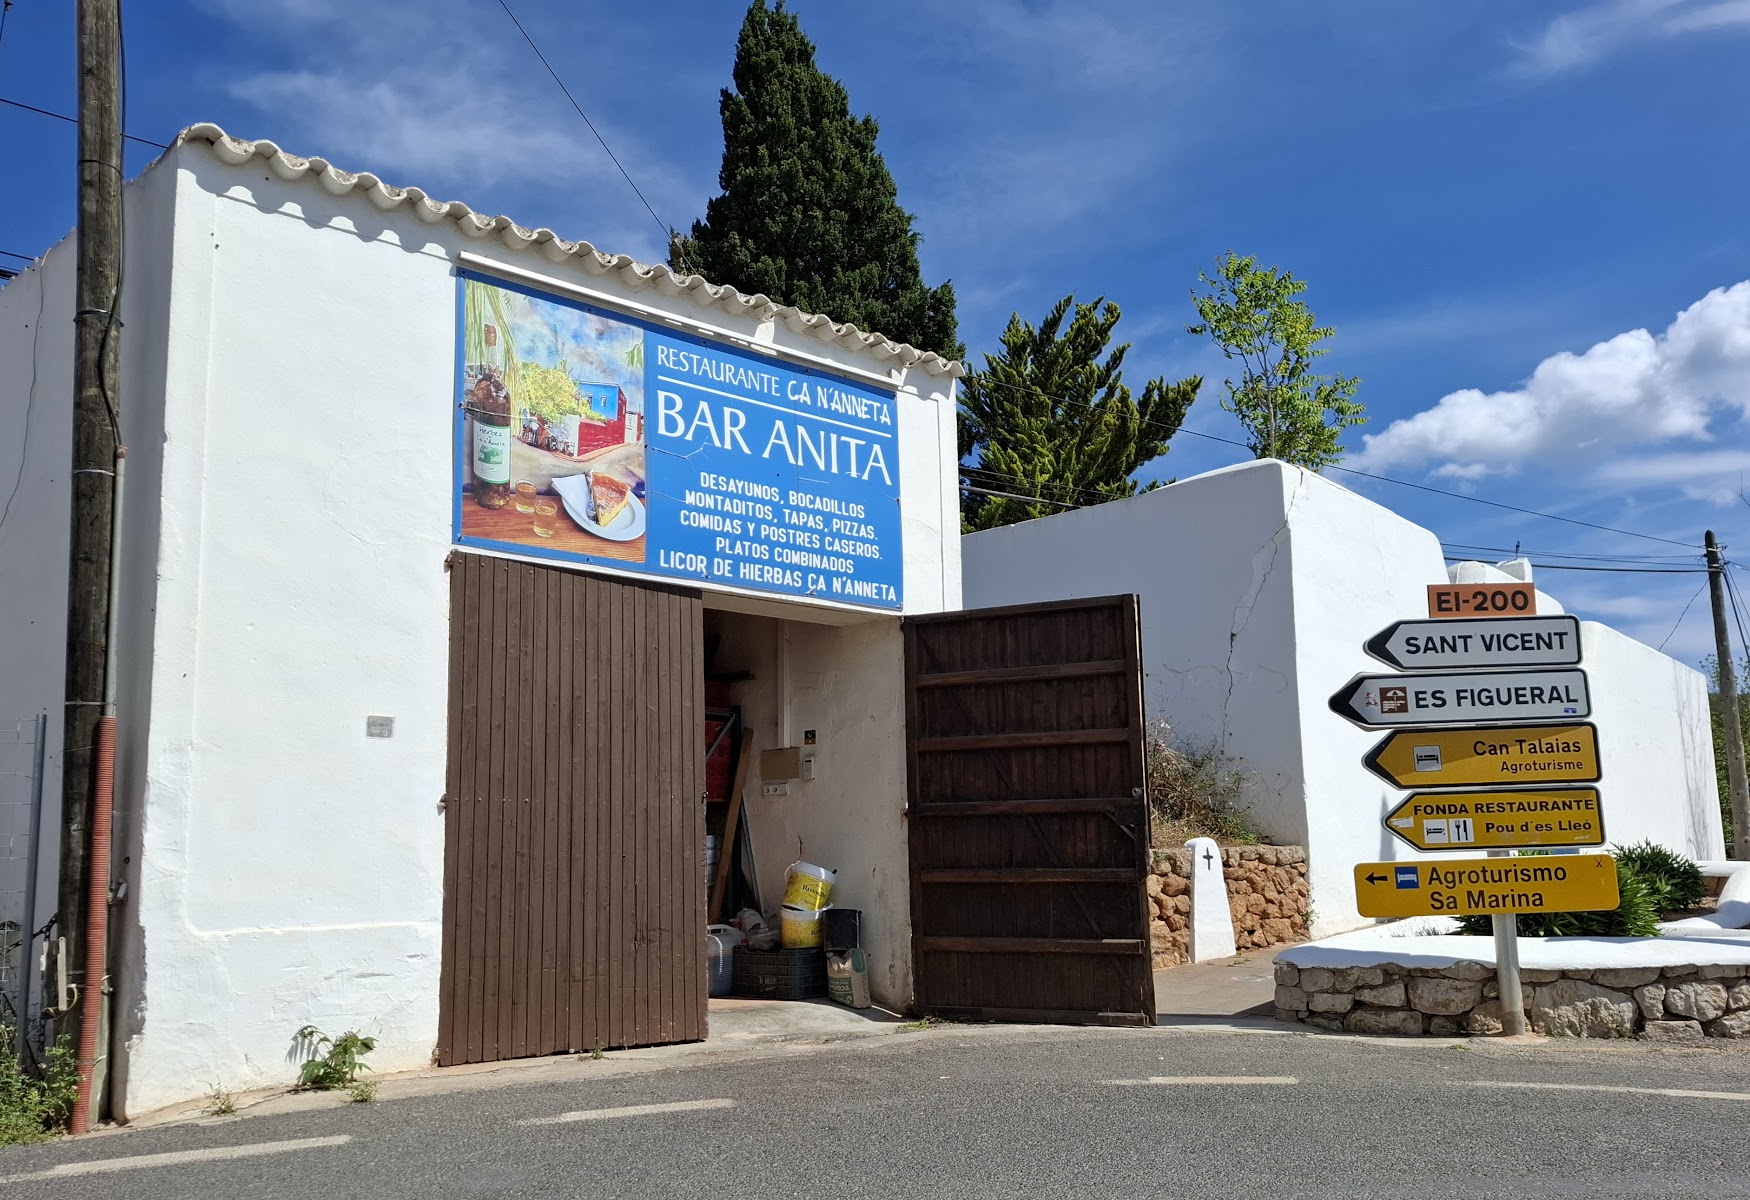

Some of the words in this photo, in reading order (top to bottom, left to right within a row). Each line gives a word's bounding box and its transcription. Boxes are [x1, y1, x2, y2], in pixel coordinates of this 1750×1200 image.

[657, 345, 780, 397] RESTAURANTE
[656, 389, 752, 455] BAR
[761, 419, 893, 486] ANITA
[700, 471, 785, 505] DESAYUNOS,
[788, 490, 865, 519] BOCADILLOS
[685, 489, 778, 524] MONTADITOS,
[782, 508, 829, 533] TAPAS,
[832, 518, 878, 541] PIZZAS.
[680, 509, 742, 535] COMIDAS
[747, 521, 756, 537] Y
[761, 524, 820, 549] POSTRES
[824, 536, 883, 560] CASEROS.
[715, 536, 770, 560] PLATOS
[774, 547, 854, 574] COMBINADOS
[659, 548, 707, 575] LICOR
[713, 557, 734, 578] DE
[740, 561, 802, 588] HIERBAS
[832, 576, 897, 602] N'ANNETA
[1436, 589, 1530, 613] EI-200
[1405, 634, 1473, 655] SANT
[1480, 631, 1568, 652] VICENT
[1414, 689, 1447, 709] ES
[1456, 685, 1579, 707] FIGUERAL
[1473, 740, 1510, 756] Can
[1515, 738, 1581, 755] Talaias
[1501, 759, 1583, 774] Agroturisme
[1413, 802, 1469, 816] FONDA
[1474, 799, 1595, 814] RESTAURANTE
[1485, 822, 1515, 833] Pou
[1558, 818, 1592, 831] Lleó
[1427, 863, 1567, 890] Agroturismo
[1429, 890, 1458, 911] Sa
[1466, 889, 1544, 909] Marina
